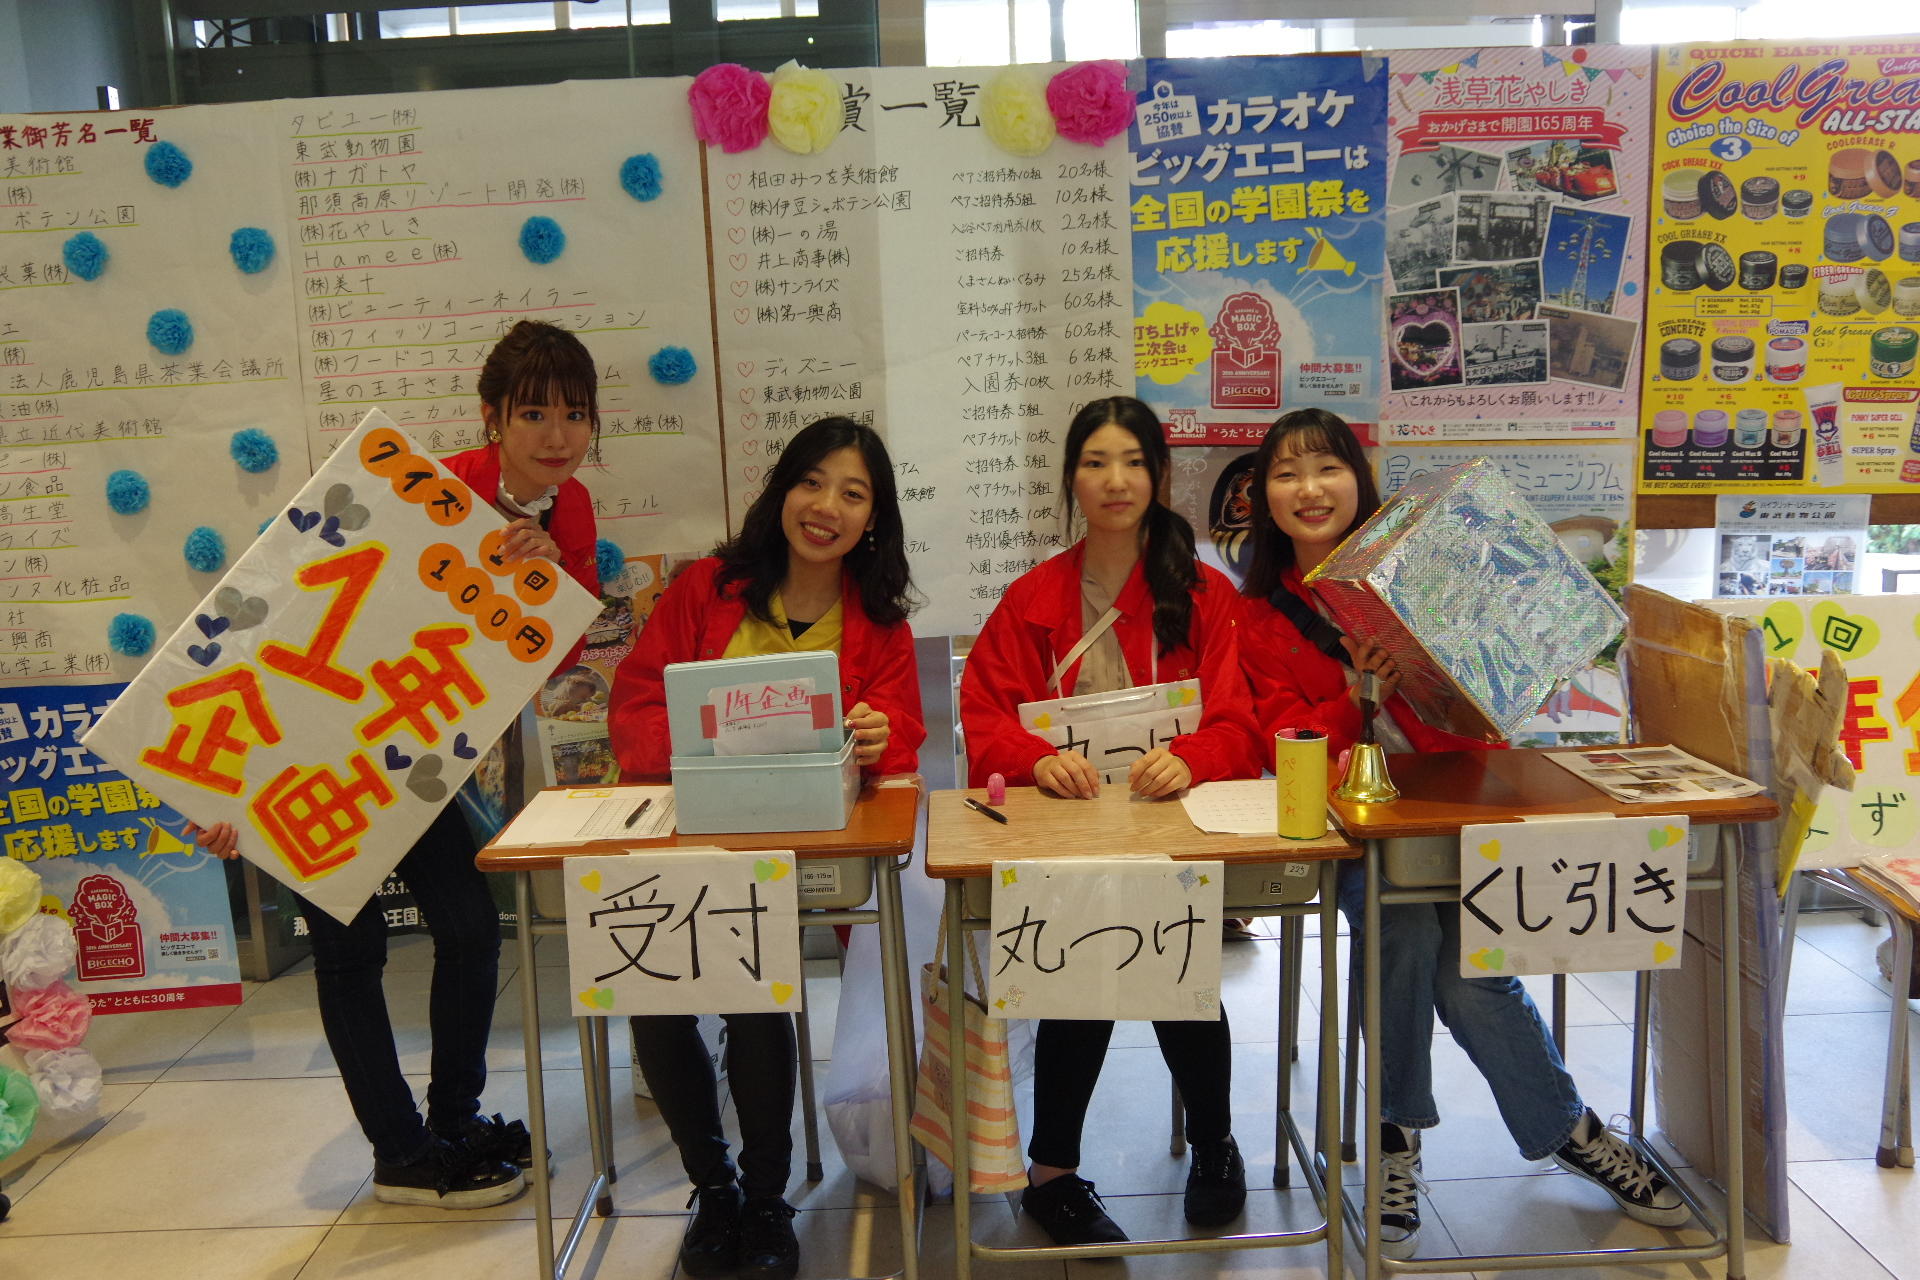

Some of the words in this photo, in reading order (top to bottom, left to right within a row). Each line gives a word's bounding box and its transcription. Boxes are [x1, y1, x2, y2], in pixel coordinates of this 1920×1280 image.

[1433, 74, 1591, 108] 浅草花やしき
[1669, 60, 1799, 120] Cool
[1206, 89, 1355, 137] カラオケ
[1667, 122, 1715, 148] Choice
[1718, 117, 1742, 135] the
[1746, 118, 1777, 141] Size
[1778, 129, 1800, 147] of
[1129, 141, 1370, 187] ビッグエコーは
[1720, 136, 1744, 161] 3
[1130, 179, 1371, 232] 全国の学園祭を
[1155, 231, 1305, 274] 応援します
[1657, 232, 1678, 244] COOL
[1680, 229, 1713, 241] GREASE
[1713, 231, 1728, 244] XX
[1231, 313, 1263, 324] MAGIC
[1236, 322, 1257, 332] BOX
[1660, 323, 1706, 338] CONCRETE
[366, 438, 467, 518] クイズ
[141, 663, 395, 881] 企画
[4, 822, 141, 864] 応援します
[87, 893, 118, 903] MAGIC
[94, 901, 114, 910] BOX
[1461, 857, 1676, 936] くじ引き
[588, 873, 768, 983] 受付
[995, 904, 1206, 984] 丸つけ
